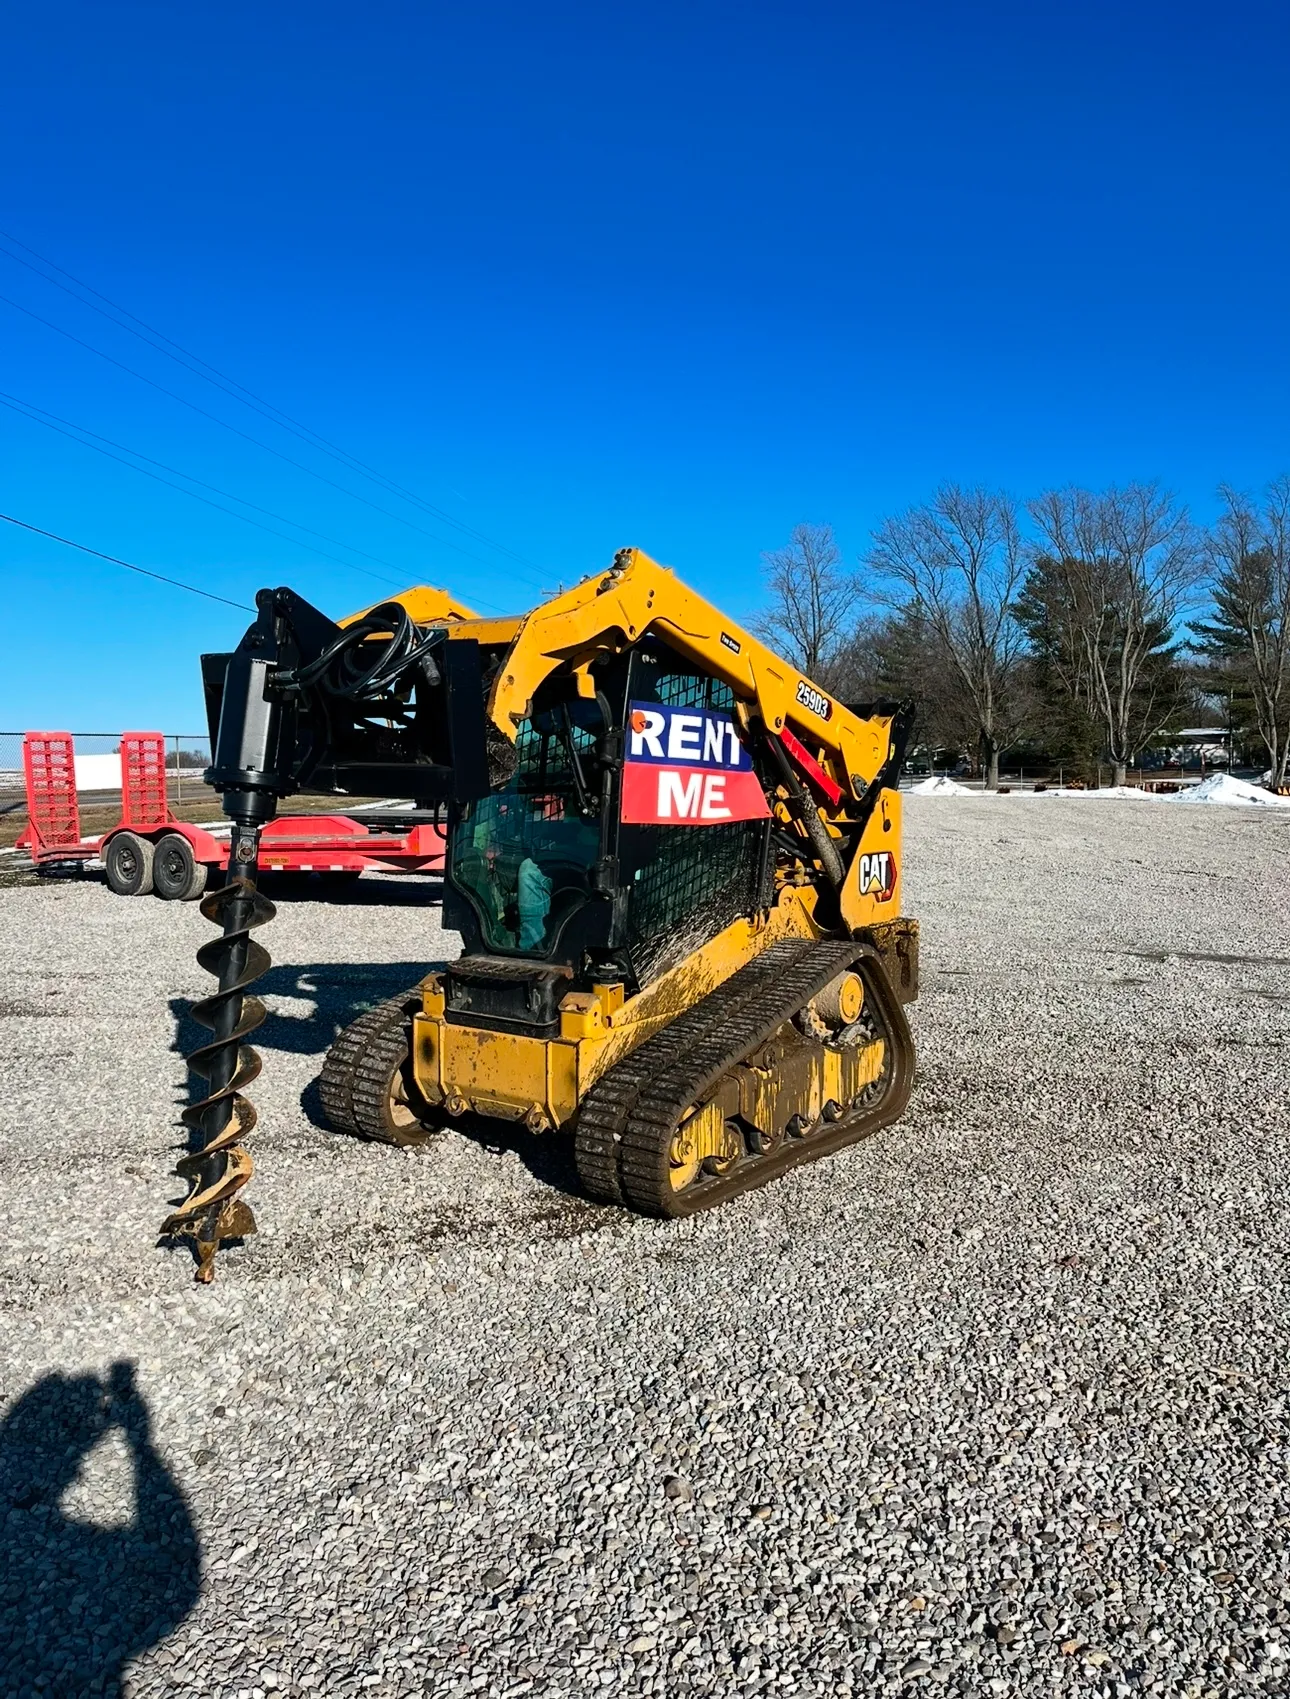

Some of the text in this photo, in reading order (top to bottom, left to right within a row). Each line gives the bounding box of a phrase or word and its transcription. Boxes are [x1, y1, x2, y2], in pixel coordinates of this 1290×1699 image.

[797, 681, 828, 718] 259D3
[630, 709, 740, 765] RENT
[657, 771, 732, 818] ME
[860, 853, 888, 894] CAT
